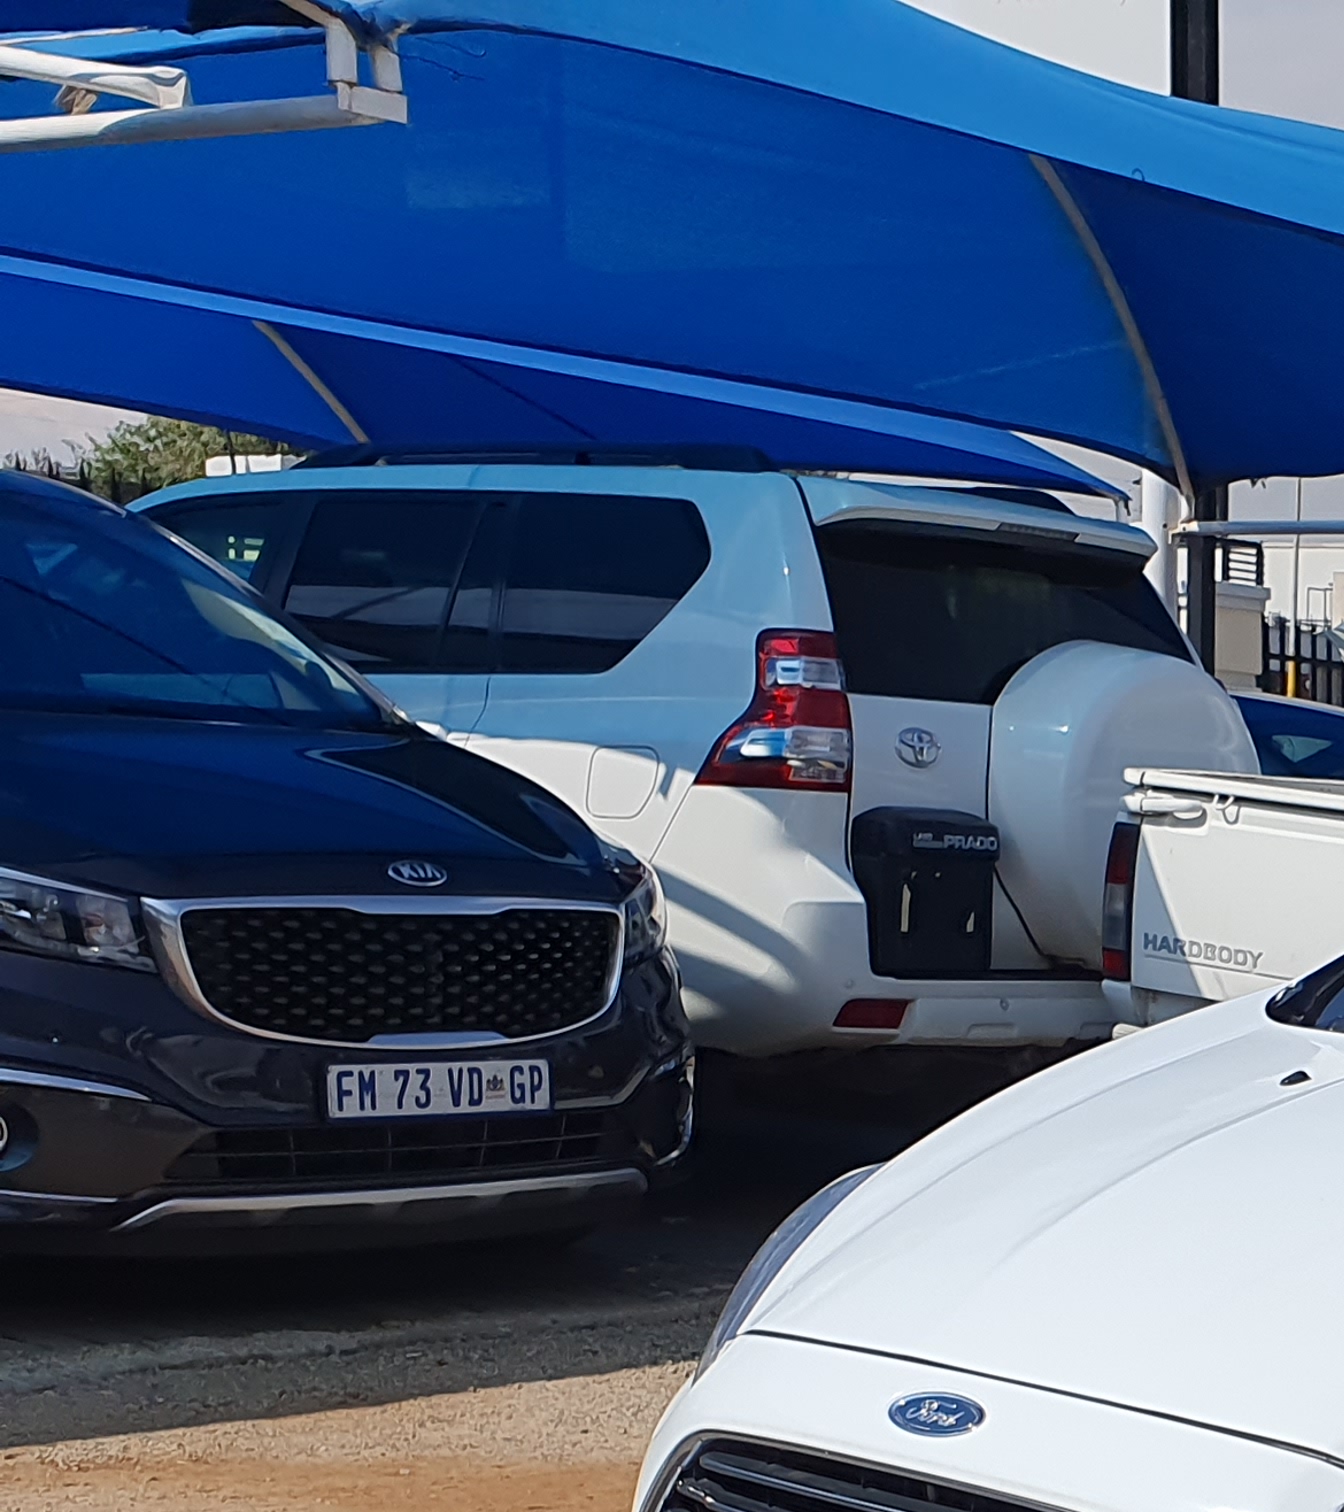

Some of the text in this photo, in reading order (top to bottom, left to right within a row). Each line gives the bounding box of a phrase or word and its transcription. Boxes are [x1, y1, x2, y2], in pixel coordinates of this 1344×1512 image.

[943, 834, 998, 851] PRADO
[393, 862, 442, 879] KIA
[1143, 932, 1263, 969] HARDBODY
[336, 1064, 543, 1112] FM 73 VD GP
[905, 1399, 966, 1427] Ford
